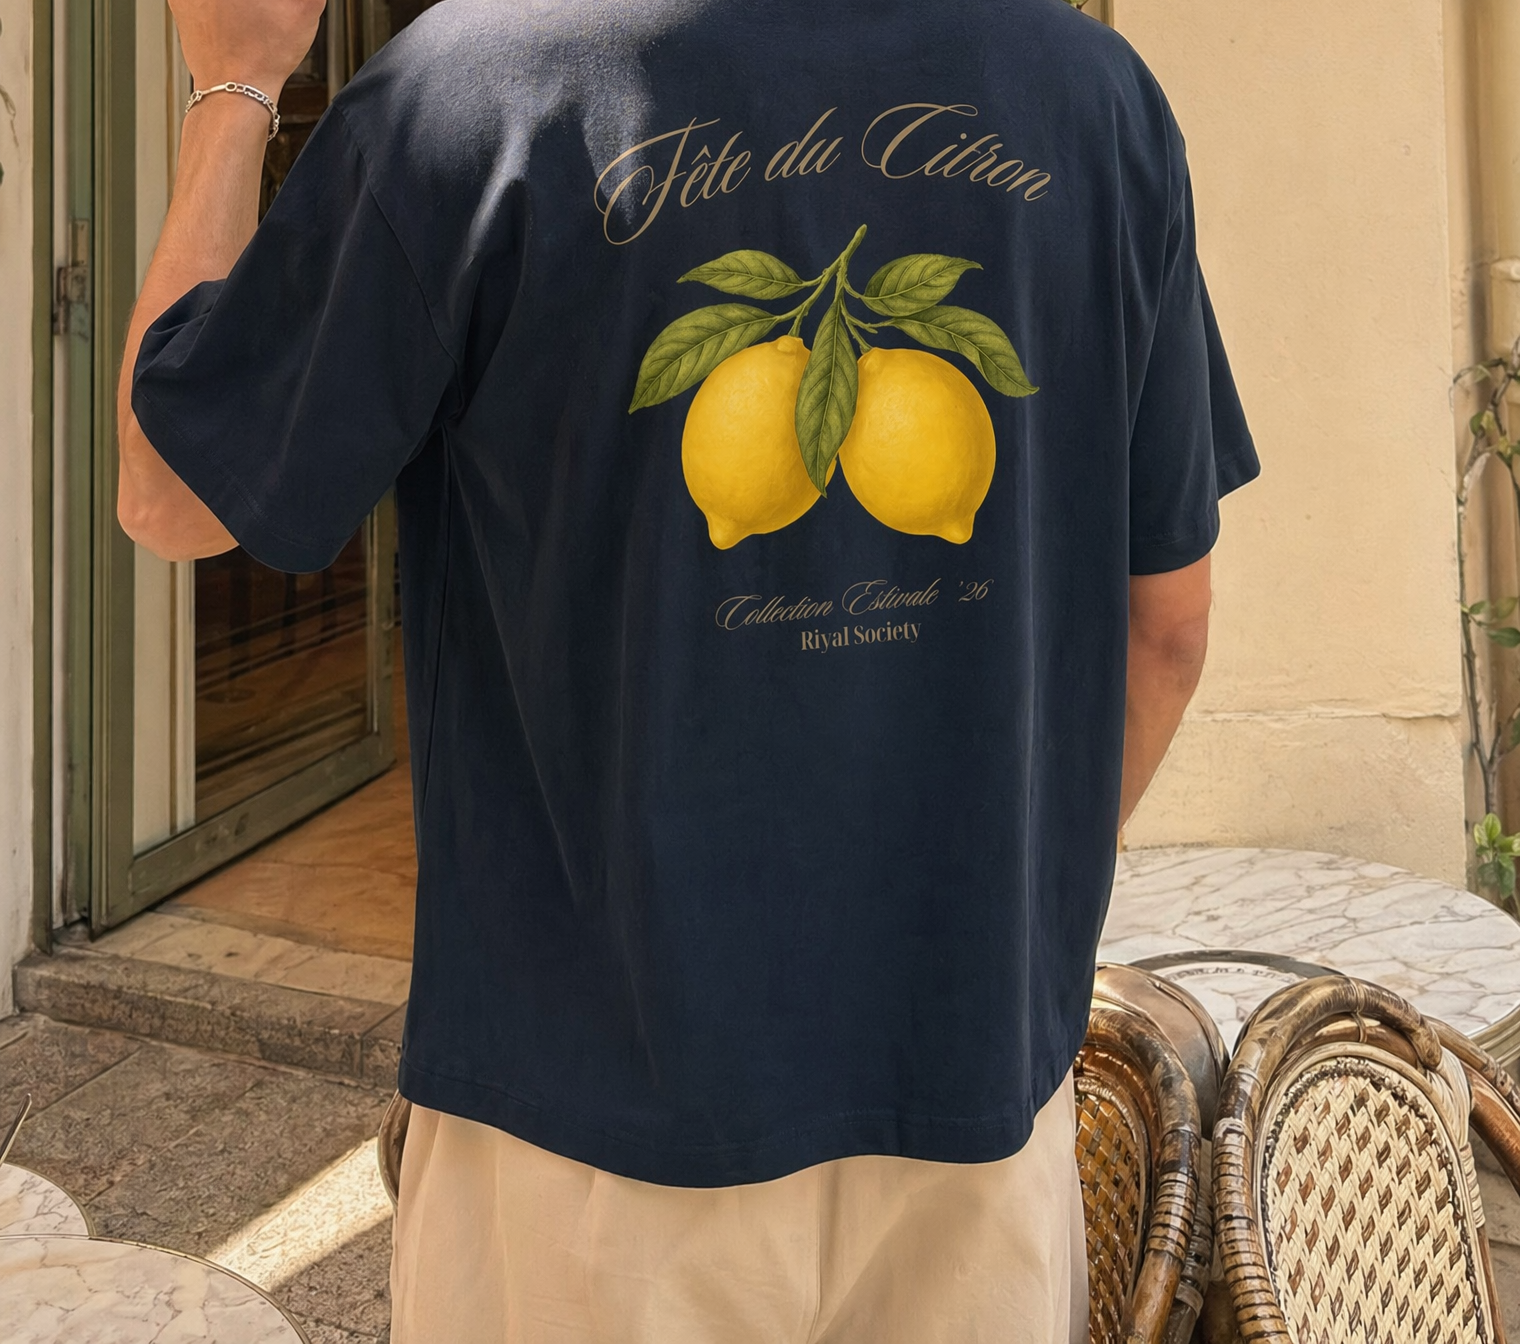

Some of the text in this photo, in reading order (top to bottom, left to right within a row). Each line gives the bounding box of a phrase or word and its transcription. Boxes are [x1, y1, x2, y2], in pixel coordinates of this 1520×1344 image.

[593, 102, 1053, 246] Fête du Citron
[715, 594, 835, 631] Collection
[841, 578, 942, 616] Estivale
[800, 621, 922, 654] Riyal Society
